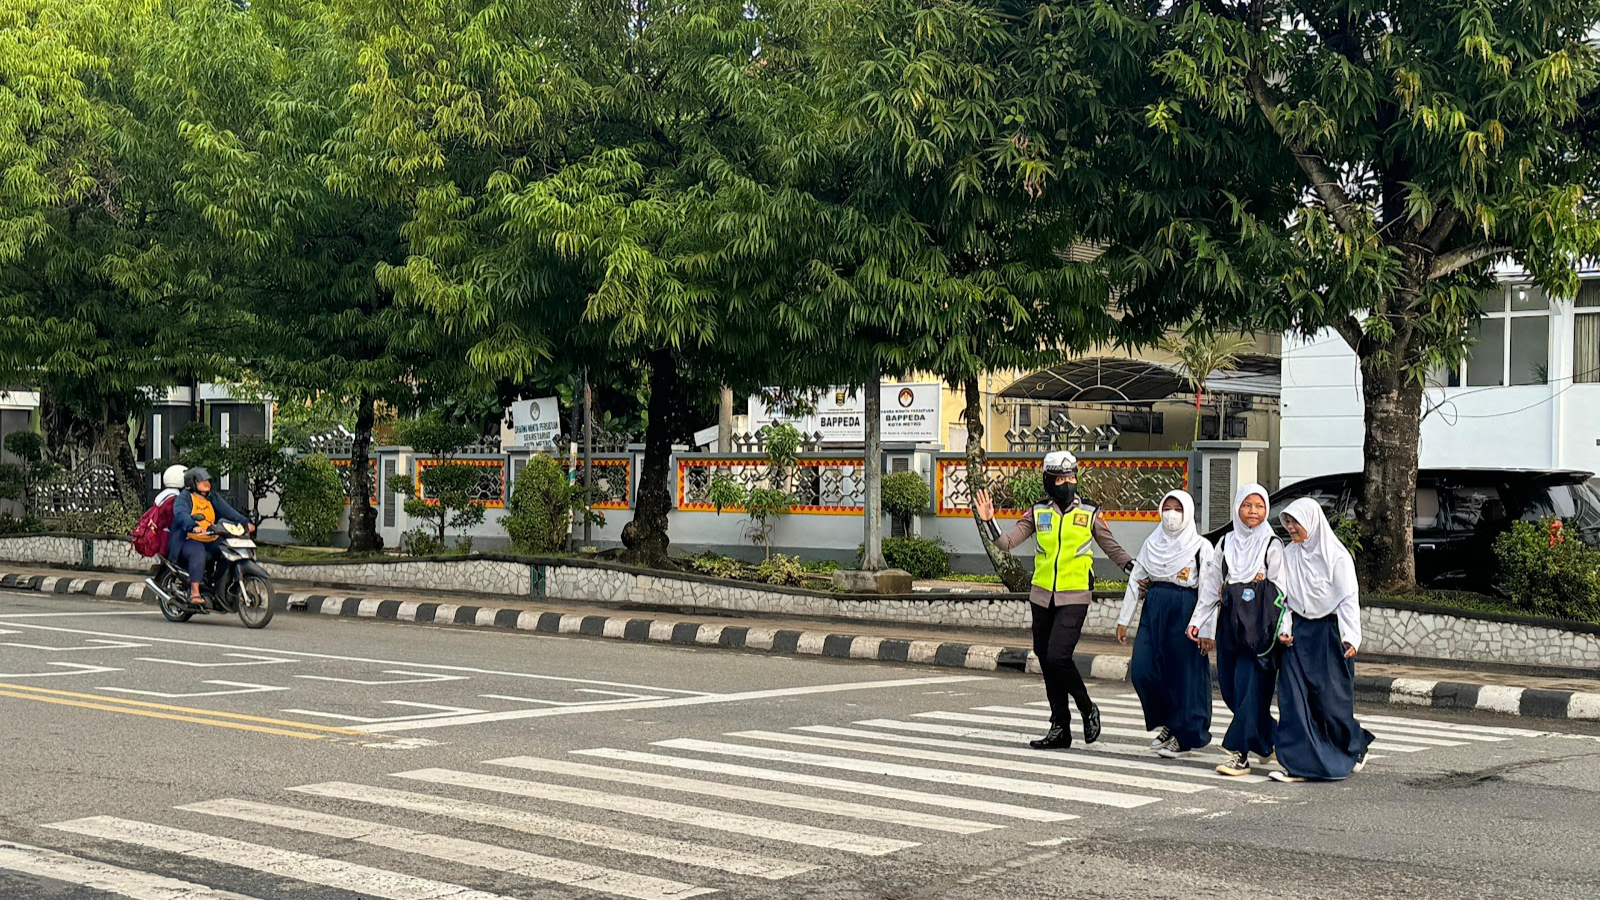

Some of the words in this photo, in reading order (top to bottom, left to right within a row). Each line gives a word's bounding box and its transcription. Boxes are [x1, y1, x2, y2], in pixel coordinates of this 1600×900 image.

[821, 416, 860, 427] BAPPEDA
[885, 414, 926, 422] BAPPEDA
[523, 431, 551, 441] SEKRETARIAT
